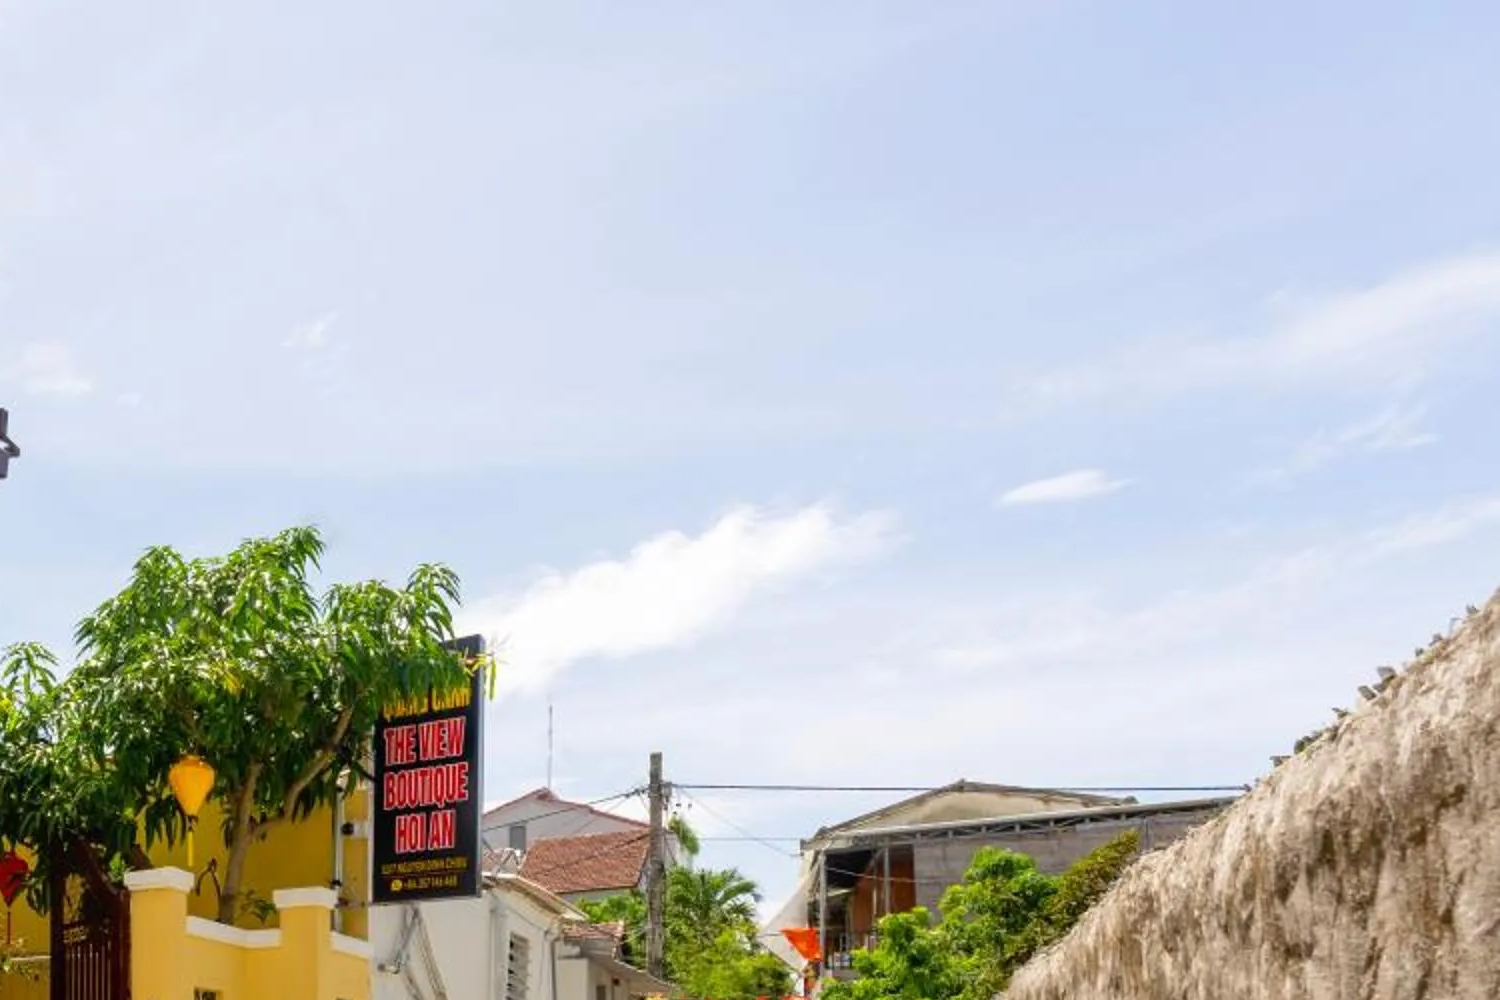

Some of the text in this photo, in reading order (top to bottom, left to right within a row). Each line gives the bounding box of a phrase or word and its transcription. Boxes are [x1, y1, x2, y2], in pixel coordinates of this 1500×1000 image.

[384, 716, 465, 765] THE VIEW
[384, 761, 468, 809] BOUTIQUE
[396, 809, 455, 853] HOI AN
